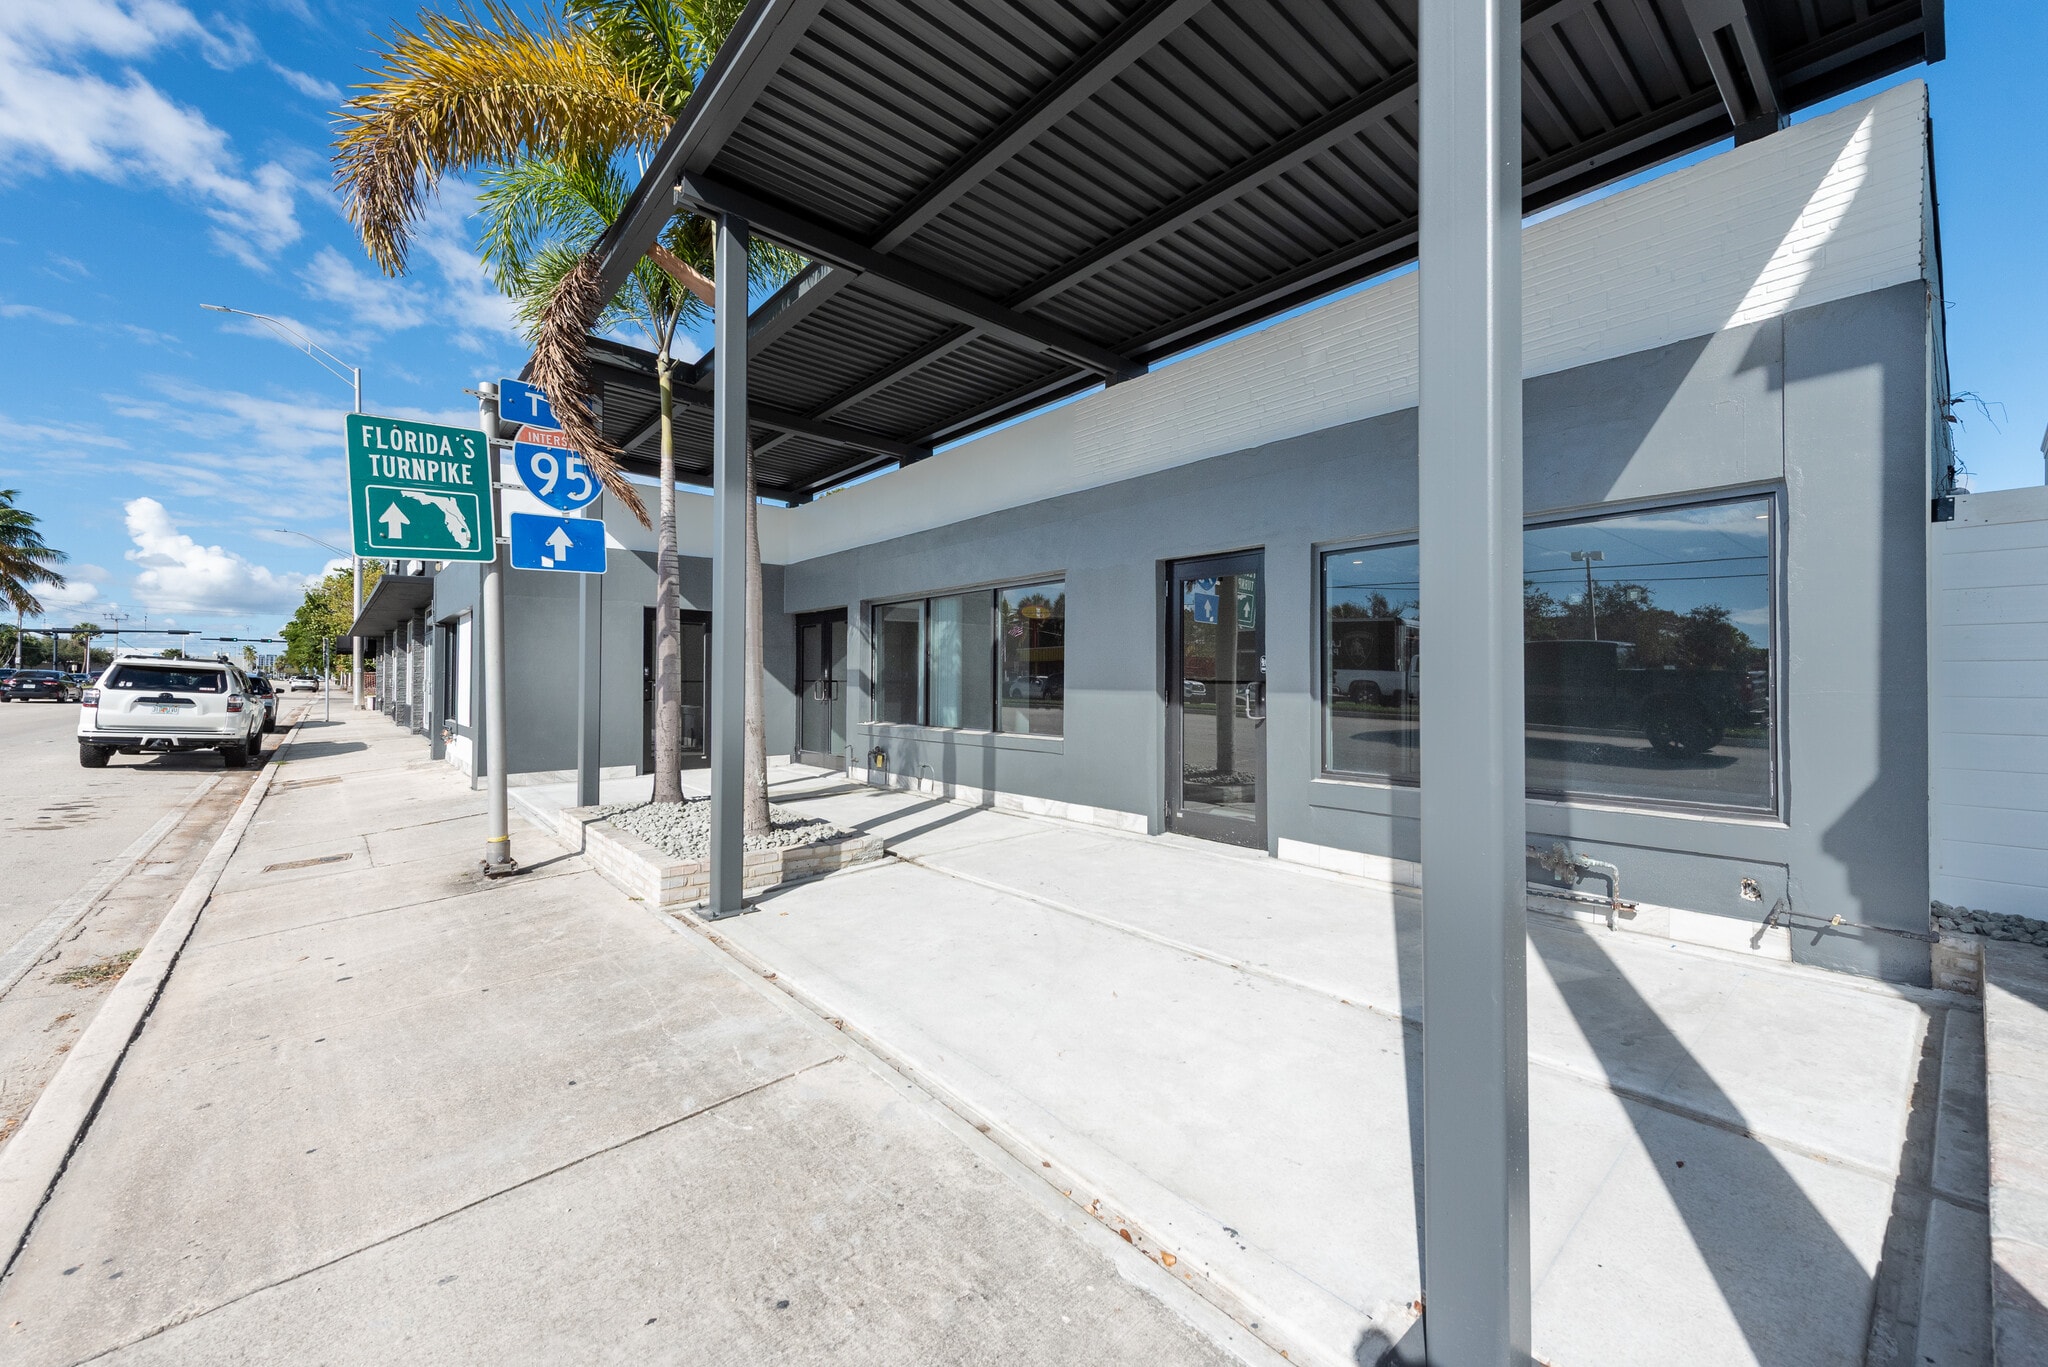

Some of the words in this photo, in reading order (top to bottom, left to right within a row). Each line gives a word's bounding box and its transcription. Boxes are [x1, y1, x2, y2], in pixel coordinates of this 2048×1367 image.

[525, 391, 552, 417] T
[361, 425, 475, 459] FLORIDA'S
[368, 454, 473, 485] TURNPIKE
[530, 452, 593, 501] 95
